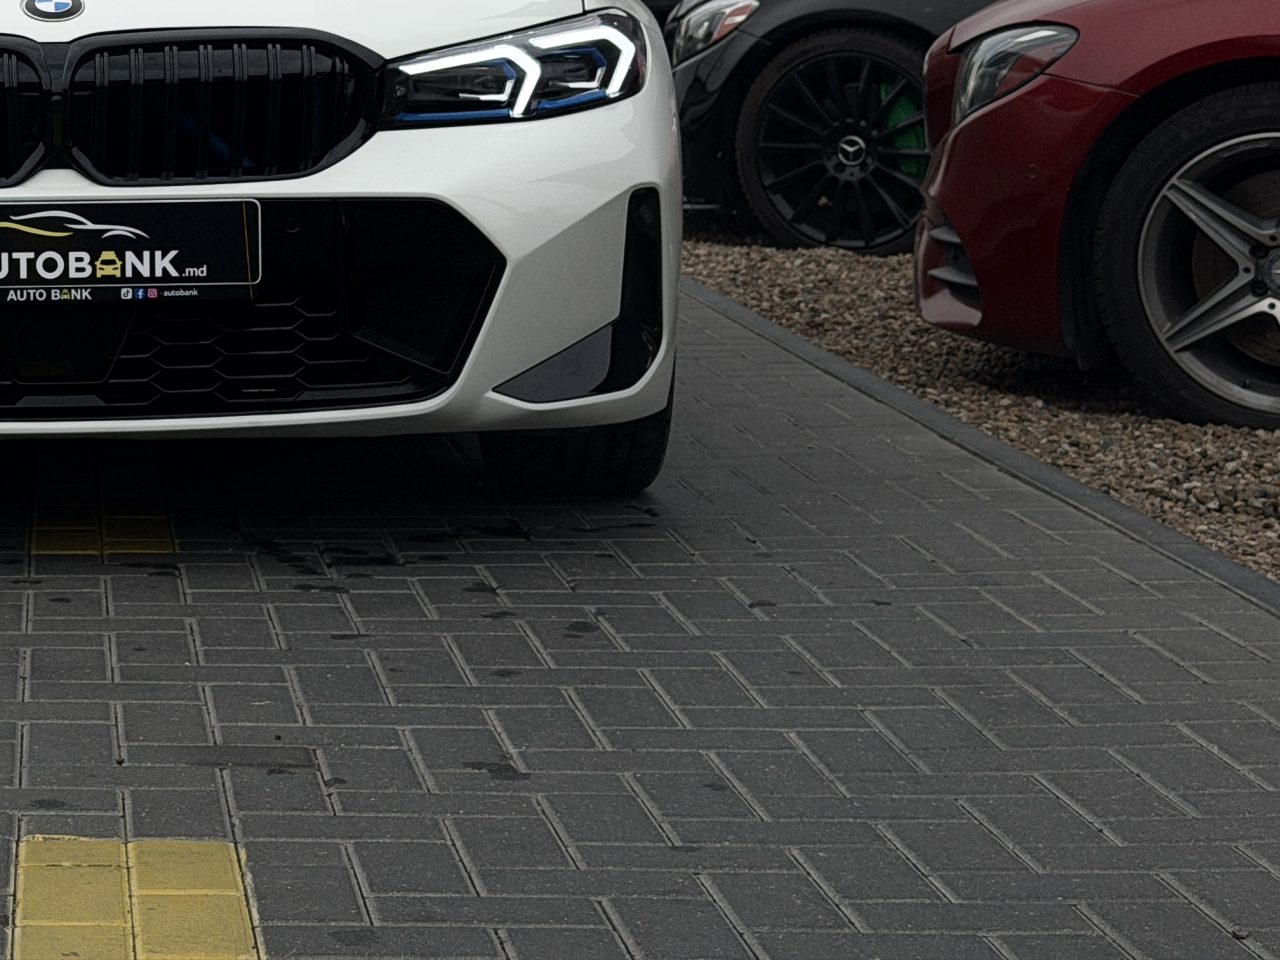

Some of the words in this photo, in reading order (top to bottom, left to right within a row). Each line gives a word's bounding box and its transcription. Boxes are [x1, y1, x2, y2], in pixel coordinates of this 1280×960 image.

[7, 289, 47, 302] AUTO
[50, 288, 93, 301] BANK
[163, 288, 199, 297] autobank
